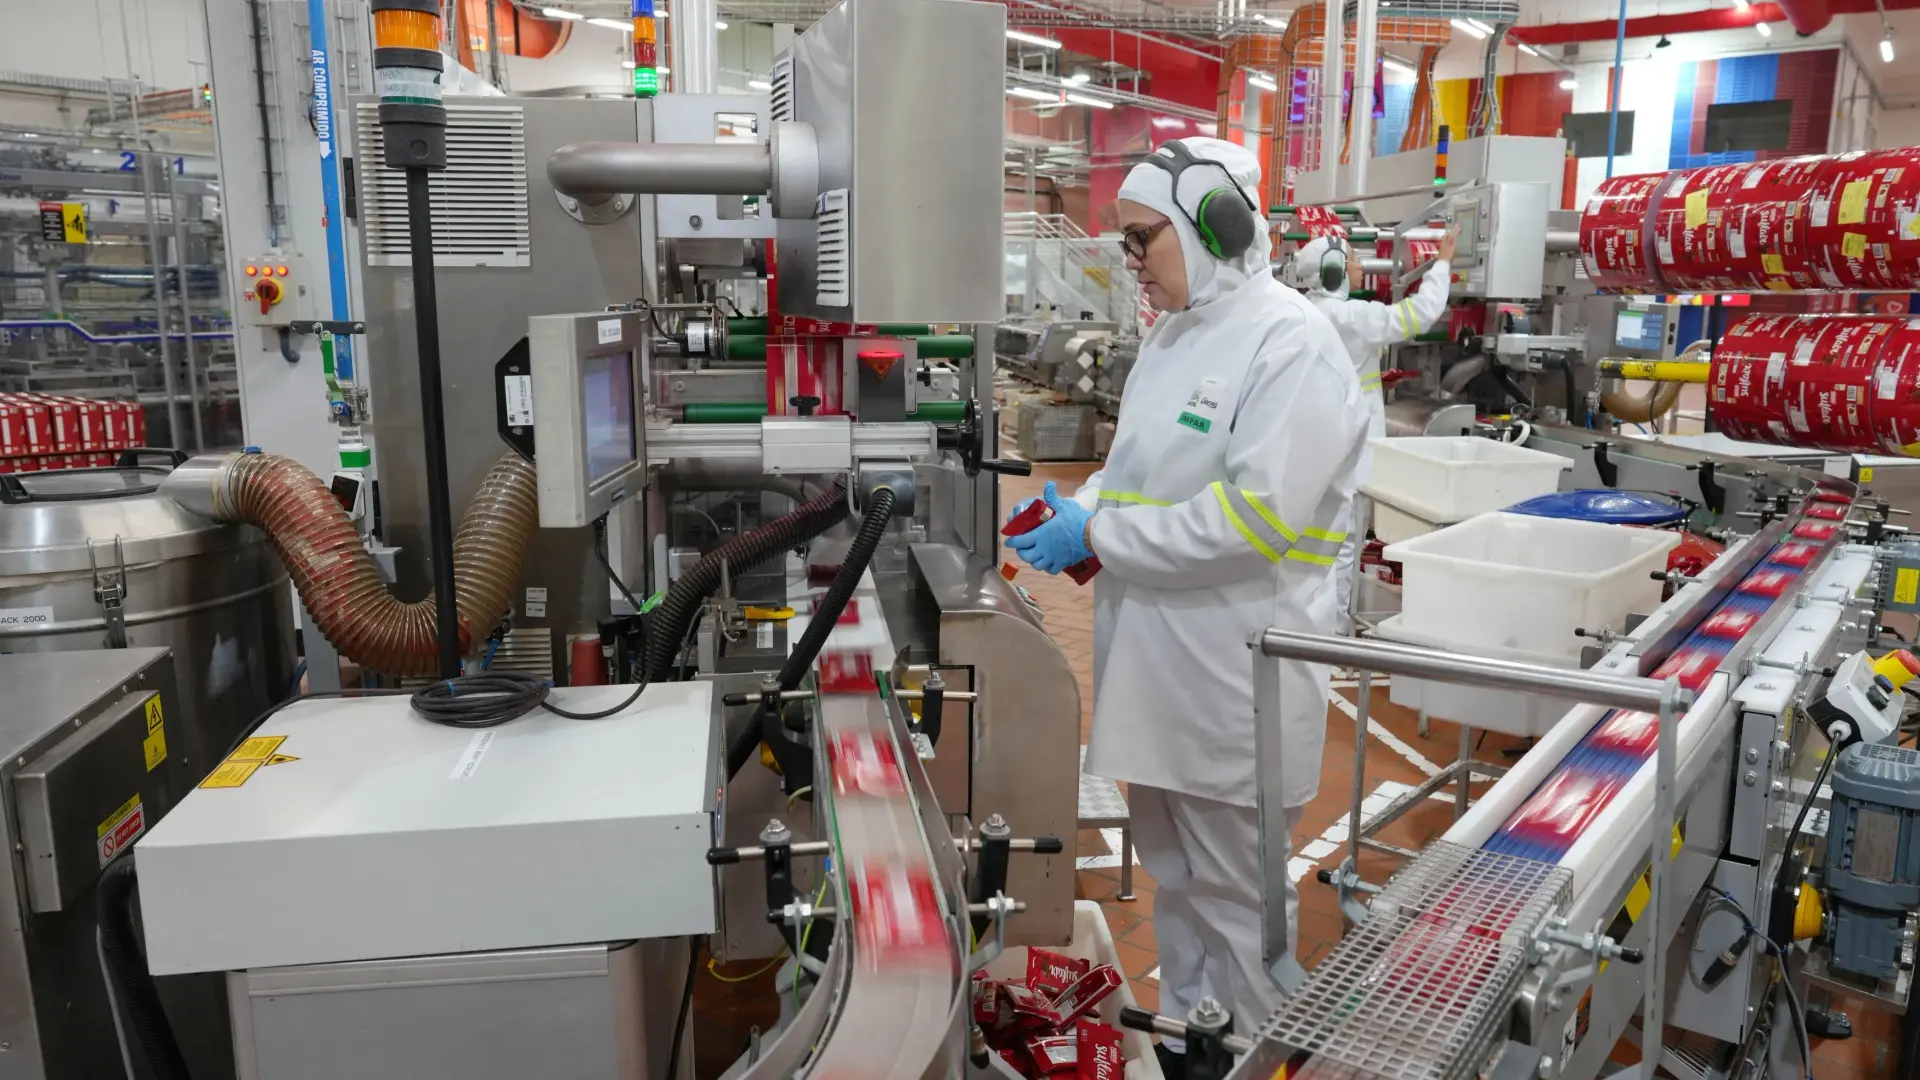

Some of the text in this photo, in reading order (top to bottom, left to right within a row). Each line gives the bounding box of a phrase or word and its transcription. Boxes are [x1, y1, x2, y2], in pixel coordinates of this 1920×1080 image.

[312, 49, 330, 139] AR COMPRIMIDO
[119, 151, 137, 172] 2
[173, 157, 185, 175] 1
[23, 614, 47, 624] 2000
